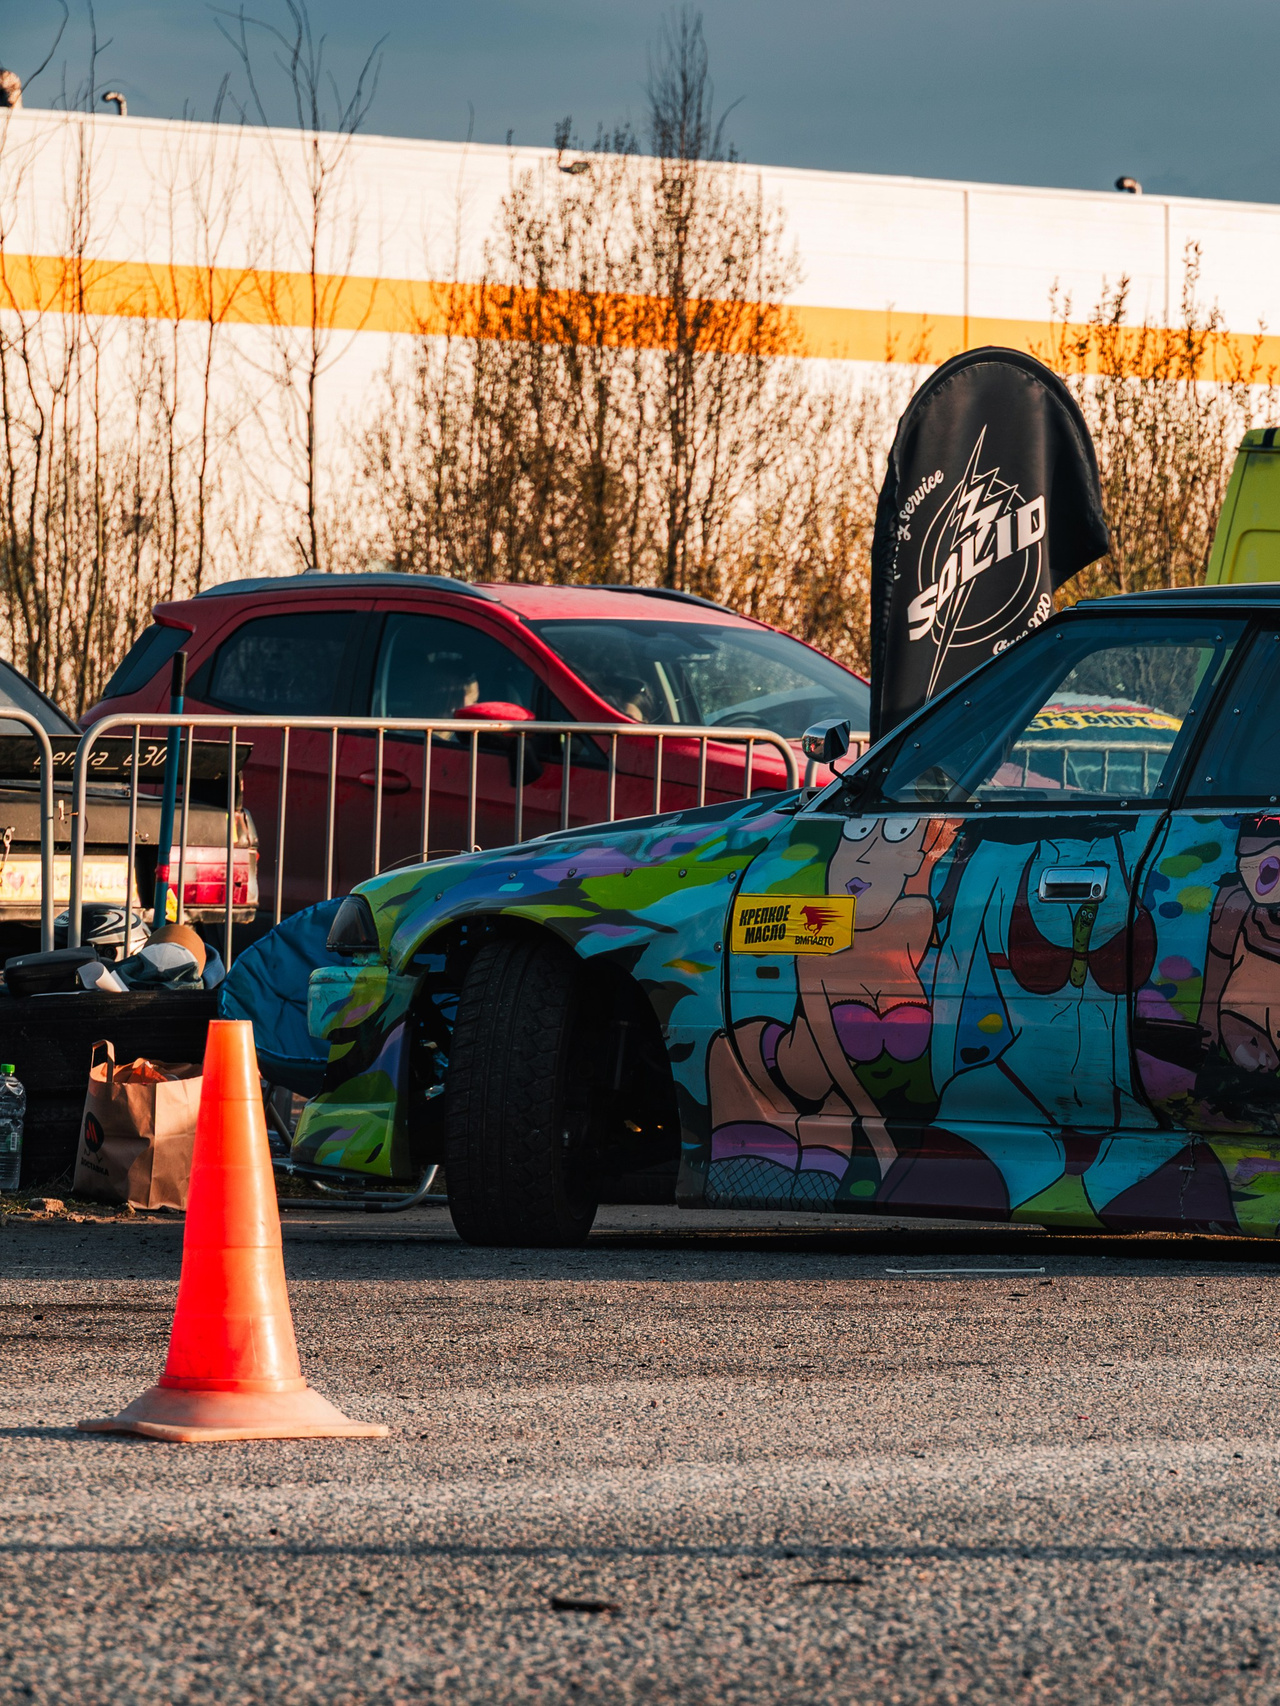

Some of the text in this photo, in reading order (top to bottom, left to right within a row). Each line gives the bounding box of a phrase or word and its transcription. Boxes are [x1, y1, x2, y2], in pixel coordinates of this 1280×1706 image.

[899, 469, 945, 521] service
[907, 495, 1046, 641] SOLID
[1029, 715, 1078, 730] ET'S
[739, 904, 791, 926] КРЕПКОЕ
[744, 923, 787, 944] МАСЛО
[795, 935, 834, 946] ВМПАВТО
